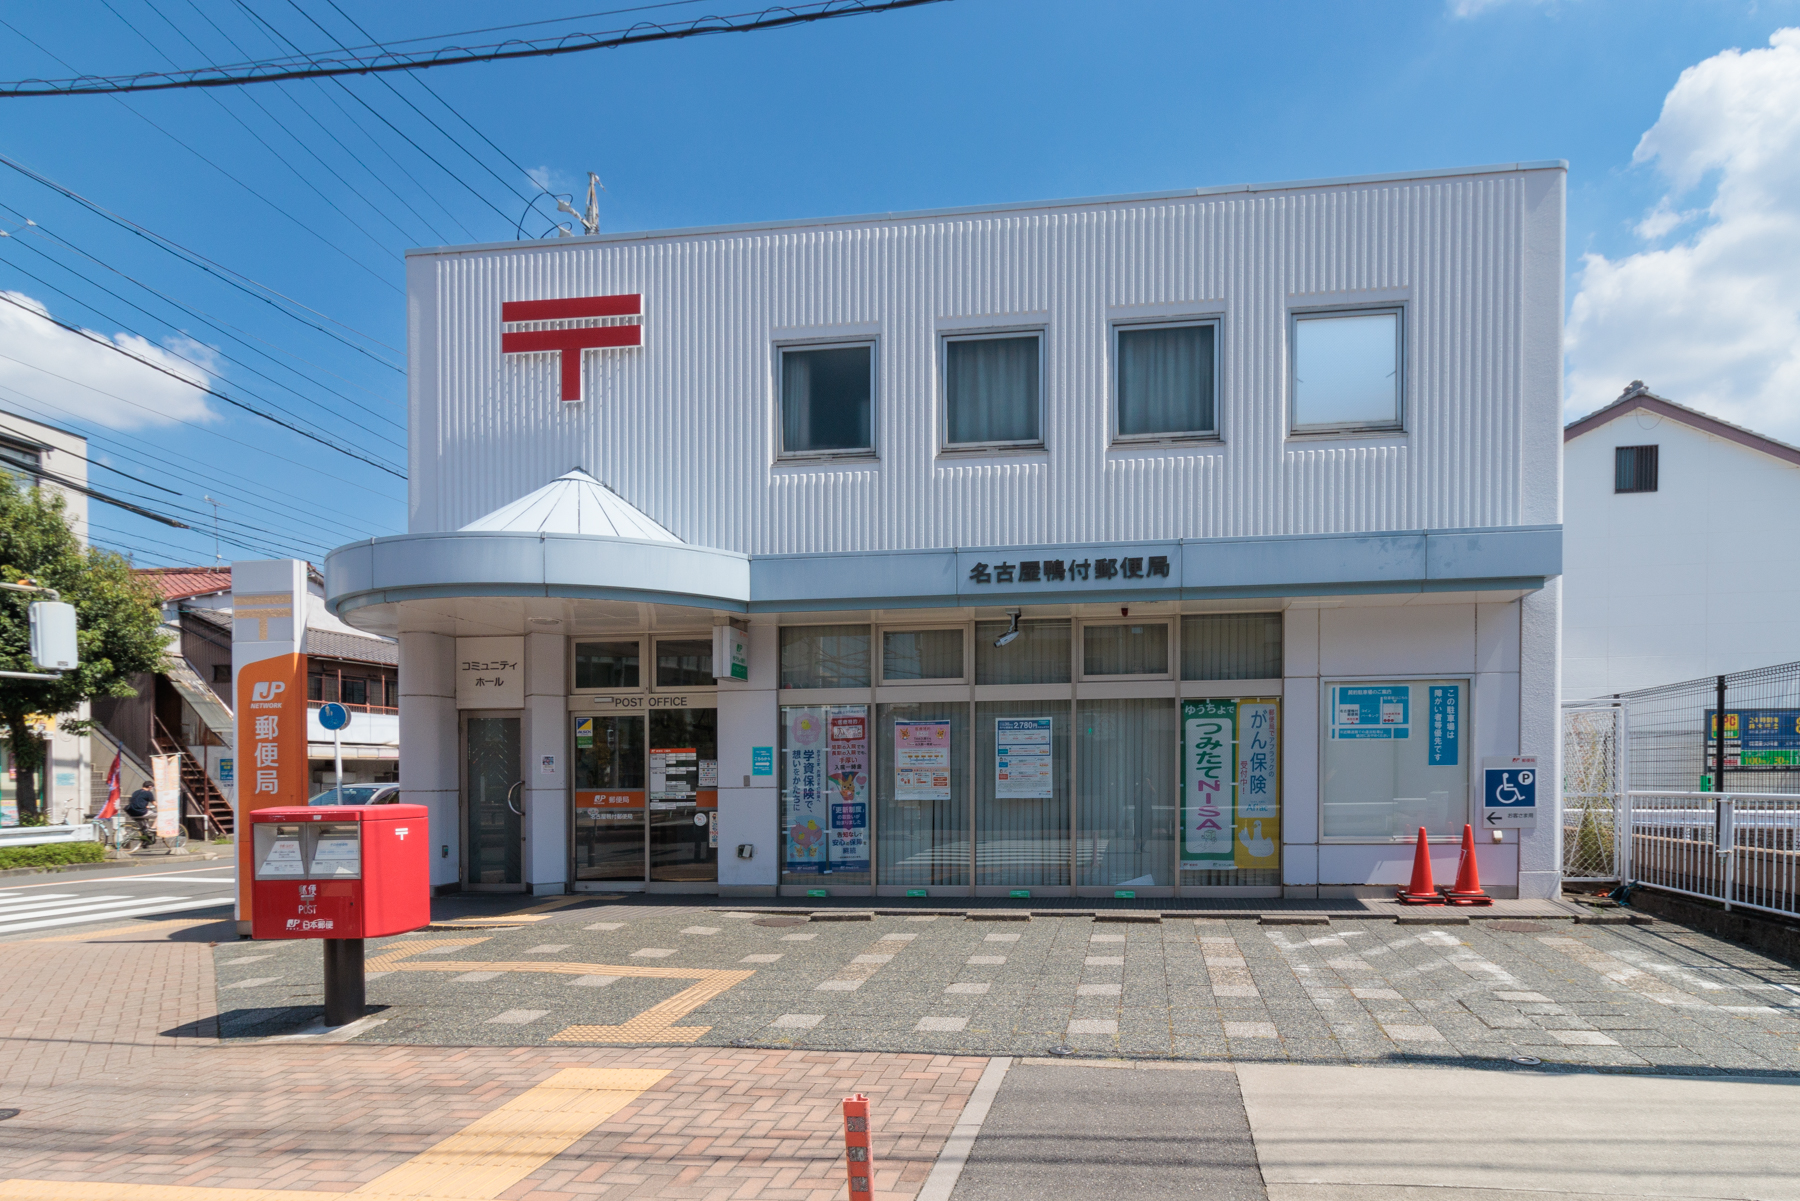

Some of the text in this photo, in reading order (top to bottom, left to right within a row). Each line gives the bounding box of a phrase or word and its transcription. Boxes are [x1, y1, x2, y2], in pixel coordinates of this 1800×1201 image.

[969, 556, 1171, 584] 名古屋鴨付郵便局
[461, 661, 518, 671] コミュニティ
[475, 677, 504, 687] ホール
[615, 697, 688, 707] POST OFFICE
[1185, 704, 1235, 715] ゆうちょで
[1446, 689, 1456, 739] この駐車場は
[1433, 689, 1443, 762] 障がい者等優先です
[254, 715, 279, 795] 郵便局
[1249, 709, 1268, 795] がん保険
[791, 749, 802, 812] 想いをかたちに
[803, 749, 815, 813] 学資保険で、
[1522, 773, 1530, 783] P
[1245, 803, 1268, 812] Aflac
[298, 884, 317, 896] 郵便
[298, 904, 317, 914] POST
[302, 919, 334, 930] 日本郵便
